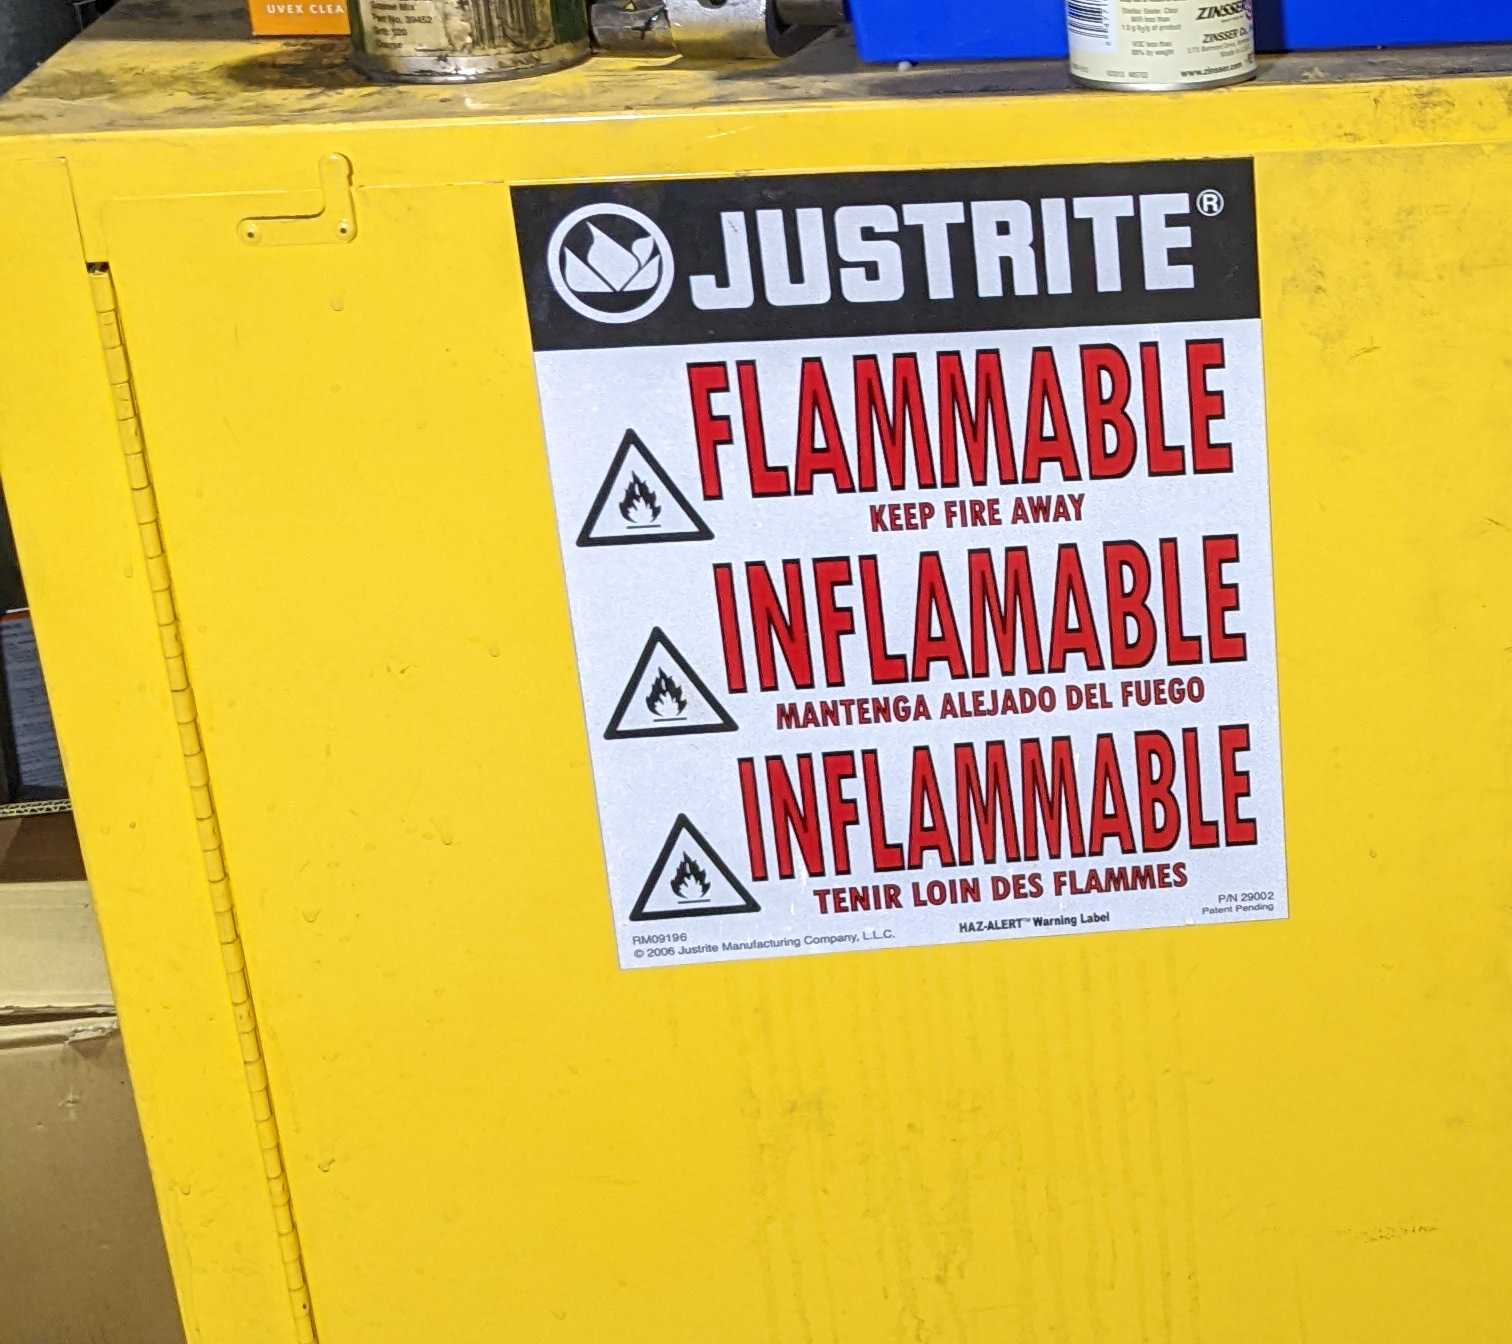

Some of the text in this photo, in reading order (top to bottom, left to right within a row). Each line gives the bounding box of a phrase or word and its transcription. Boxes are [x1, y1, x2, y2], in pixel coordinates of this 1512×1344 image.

[266, 4, 345, 14] UVEX CLEA
[686, 338, 1234, 501] FLAMMABLE
[870, 493, 1086, 532] KEEP FIRE AWAY
[712, 533, 1248, 695] INFLAMABLE
[776, 676, 1206, 730] MANTENGA ALEJADO DEL FUEGO
[737, 723, 1259, 883] INFLAMMABLE
[813, 862, 1189, 915] TENIR LOIN DES FLAMMES
[1218, 891, 1275, 904] P/N 29002
[1033, 914, 1077, 928] Warning
[1080, 912, 1110, 924] Label
[1202, 902, 1275, 915] Patent Pending
[632, 932, 688, 946] RM09196
[647, 947, 676, 958] 2006
[678, 943, 719, 956] Justrite
[722, 937, 801, 952] Manufacturing
[804, 932, 861, 946] Company,
[862, 929, 896, 941] L.L.C.
